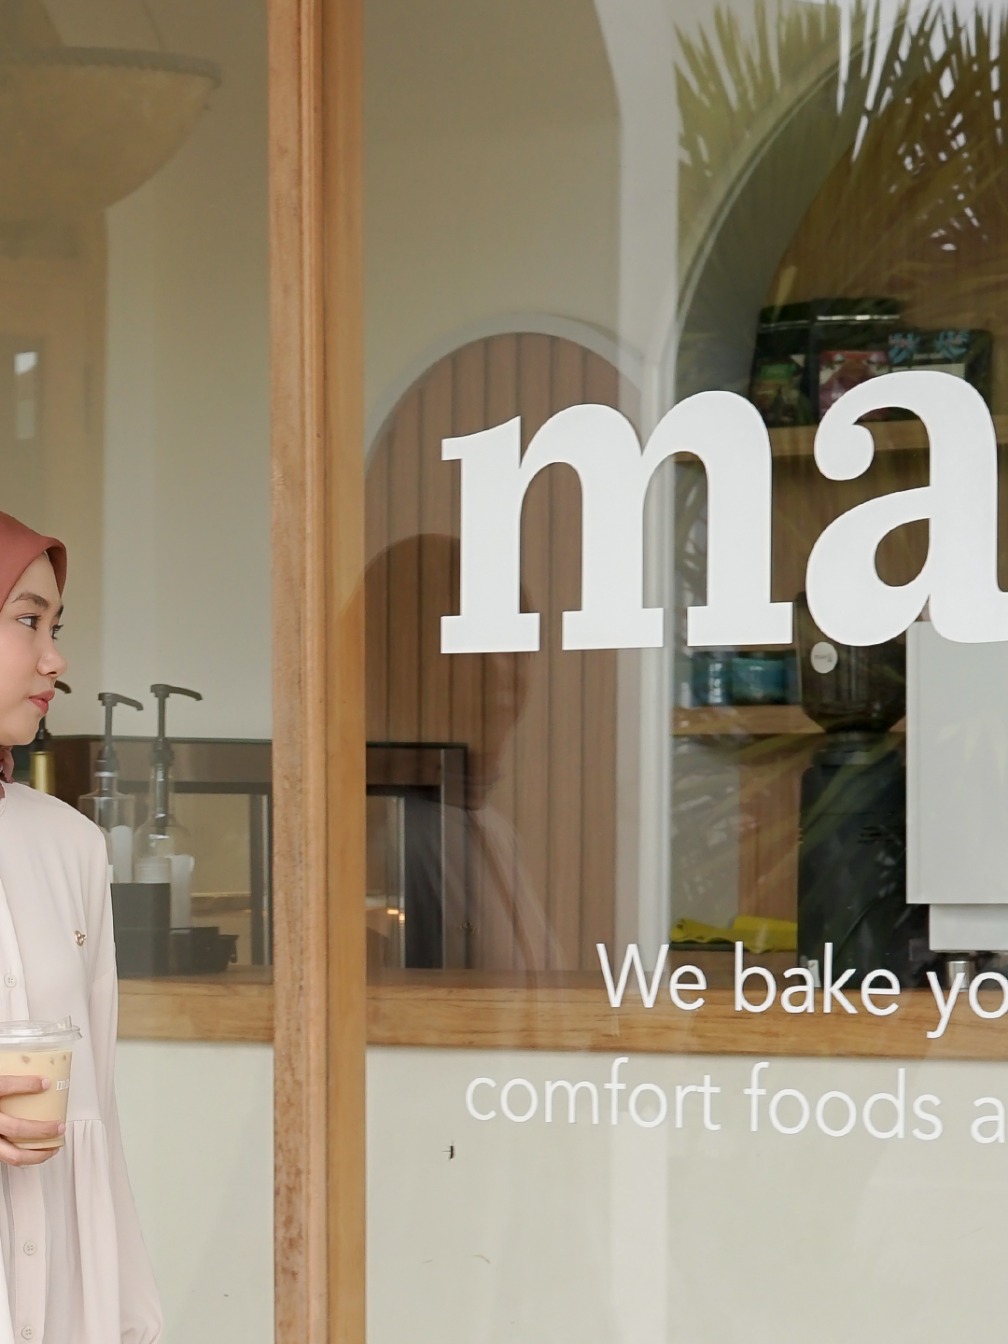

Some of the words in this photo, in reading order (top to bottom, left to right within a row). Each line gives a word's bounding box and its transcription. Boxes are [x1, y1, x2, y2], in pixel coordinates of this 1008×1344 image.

[441, 370, 1008, 654] ma
[597, 943, 706, 1010] We
[735, 941, 900, 1016] bake
[926, 971, 1008, 1039] yo
[466, 1057, 721, 1131] comfort
[743, 1061, 943, 1141] foods
[970, 1096, 1005, 1144] a
